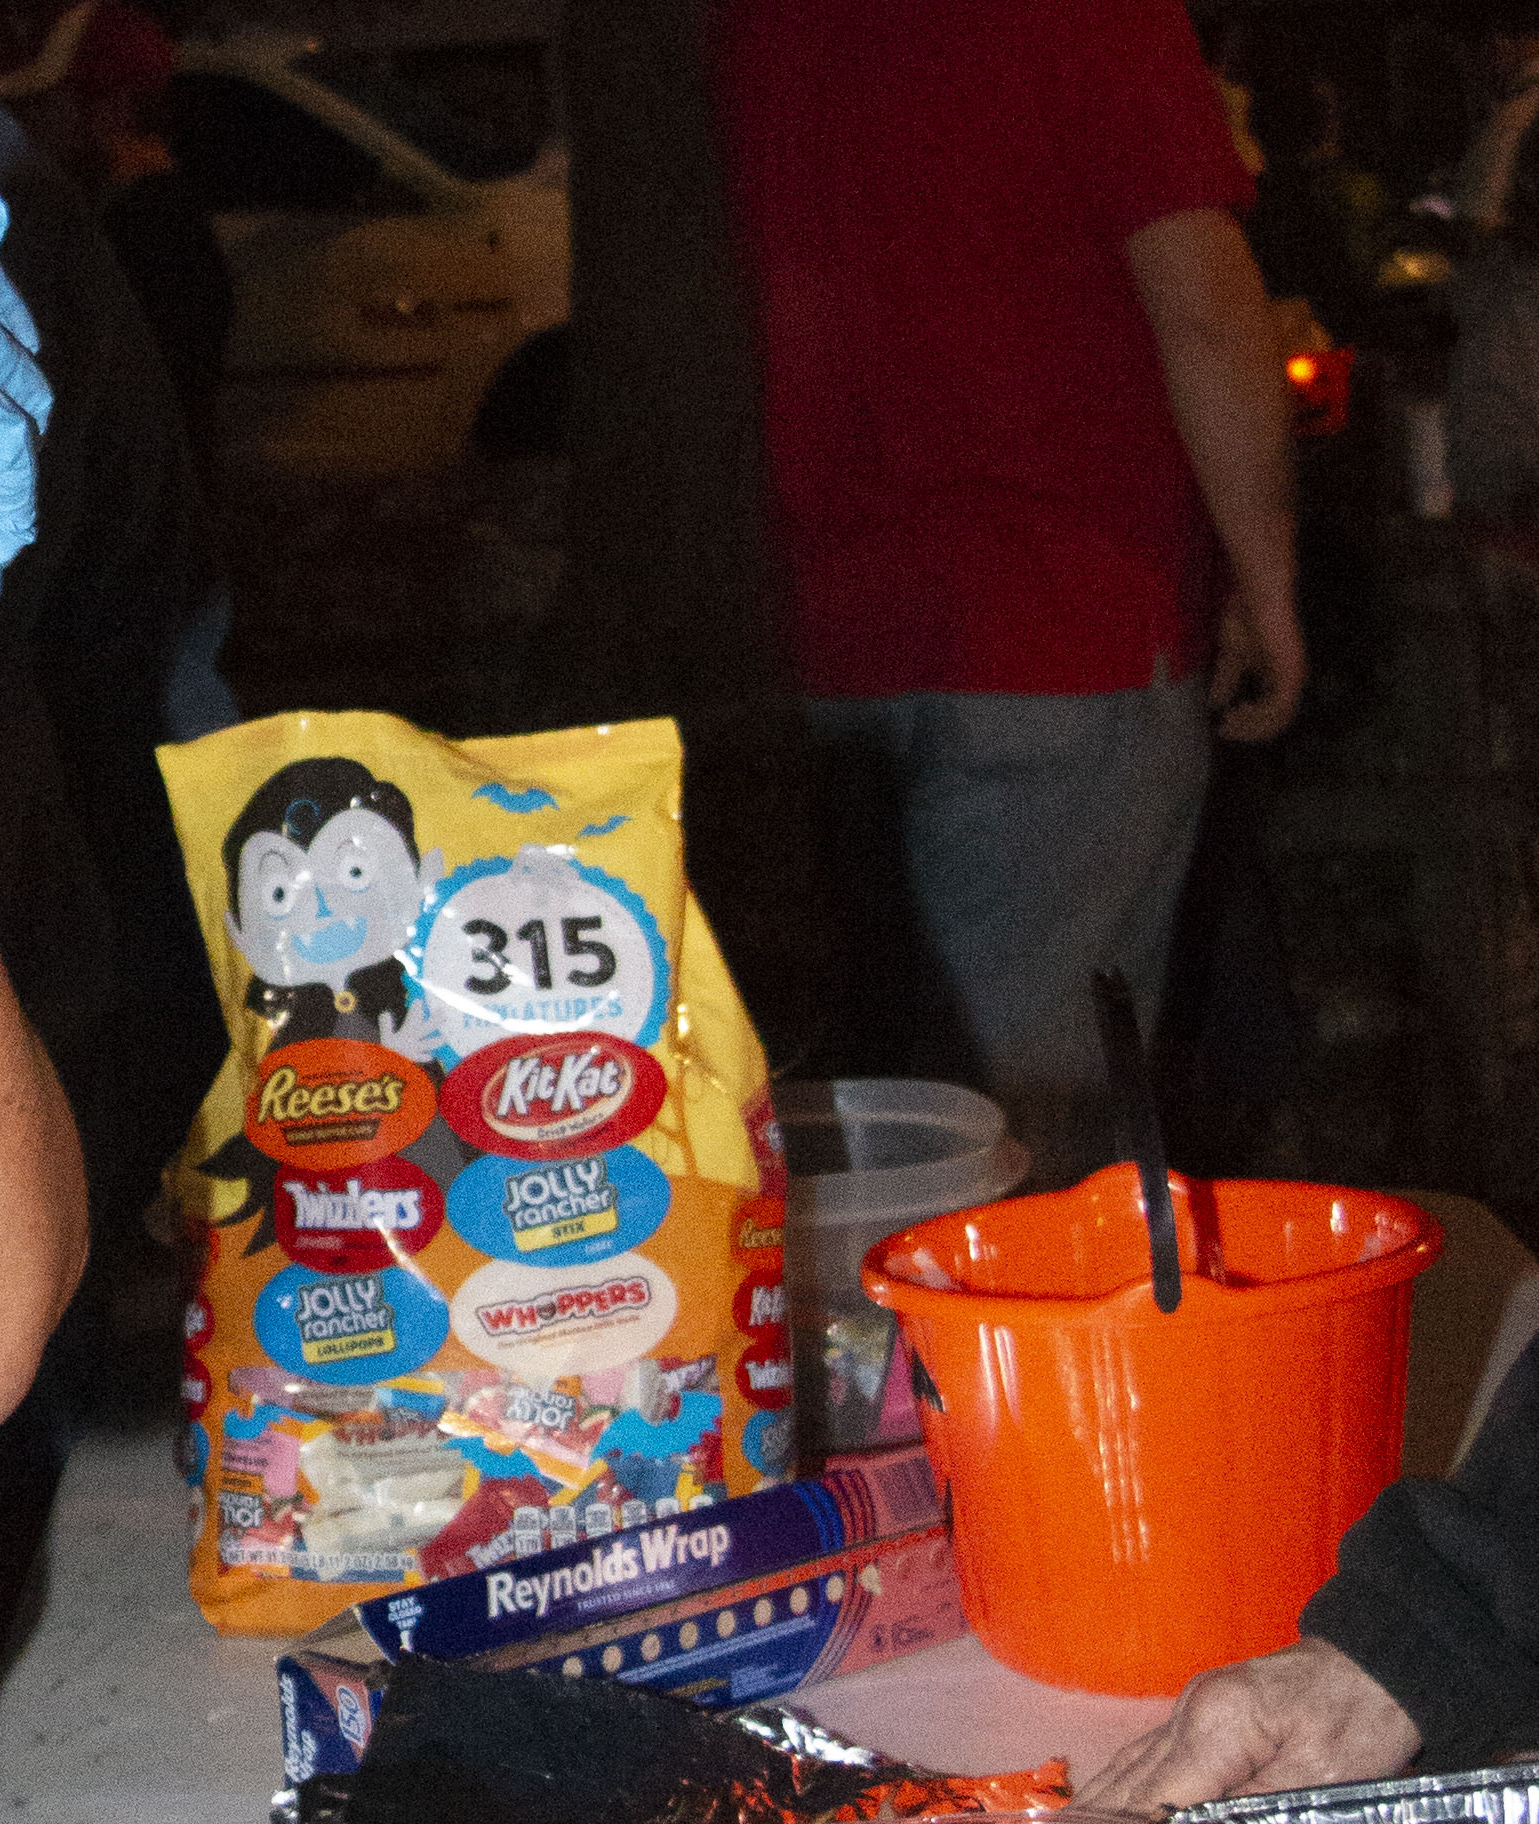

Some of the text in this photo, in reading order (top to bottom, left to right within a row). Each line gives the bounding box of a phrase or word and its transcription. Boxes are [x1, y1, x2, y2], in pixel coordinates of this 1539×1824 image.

[462, 915, 616, 994] 315
[257, 1064, 407, 1123] Reese's
[282, 1178, 422, 1231] Twizzlers
[507, 1160, 600, 1212] JOLLY
[515, 1189, 613, 1229] rancher
[297, 1279, 376, 1321] JOLLY
[304, 1308, 387, 1340] rancher
[481, 1281, 647, 1330] WHOPPERS
[485, 1542, 640, 1619] Reynolds
[639, 1525, 729, 1573] Wrap
[280, 1672, 302, 1782] Reynolds
[338, 1686, 363, 1746] 150
